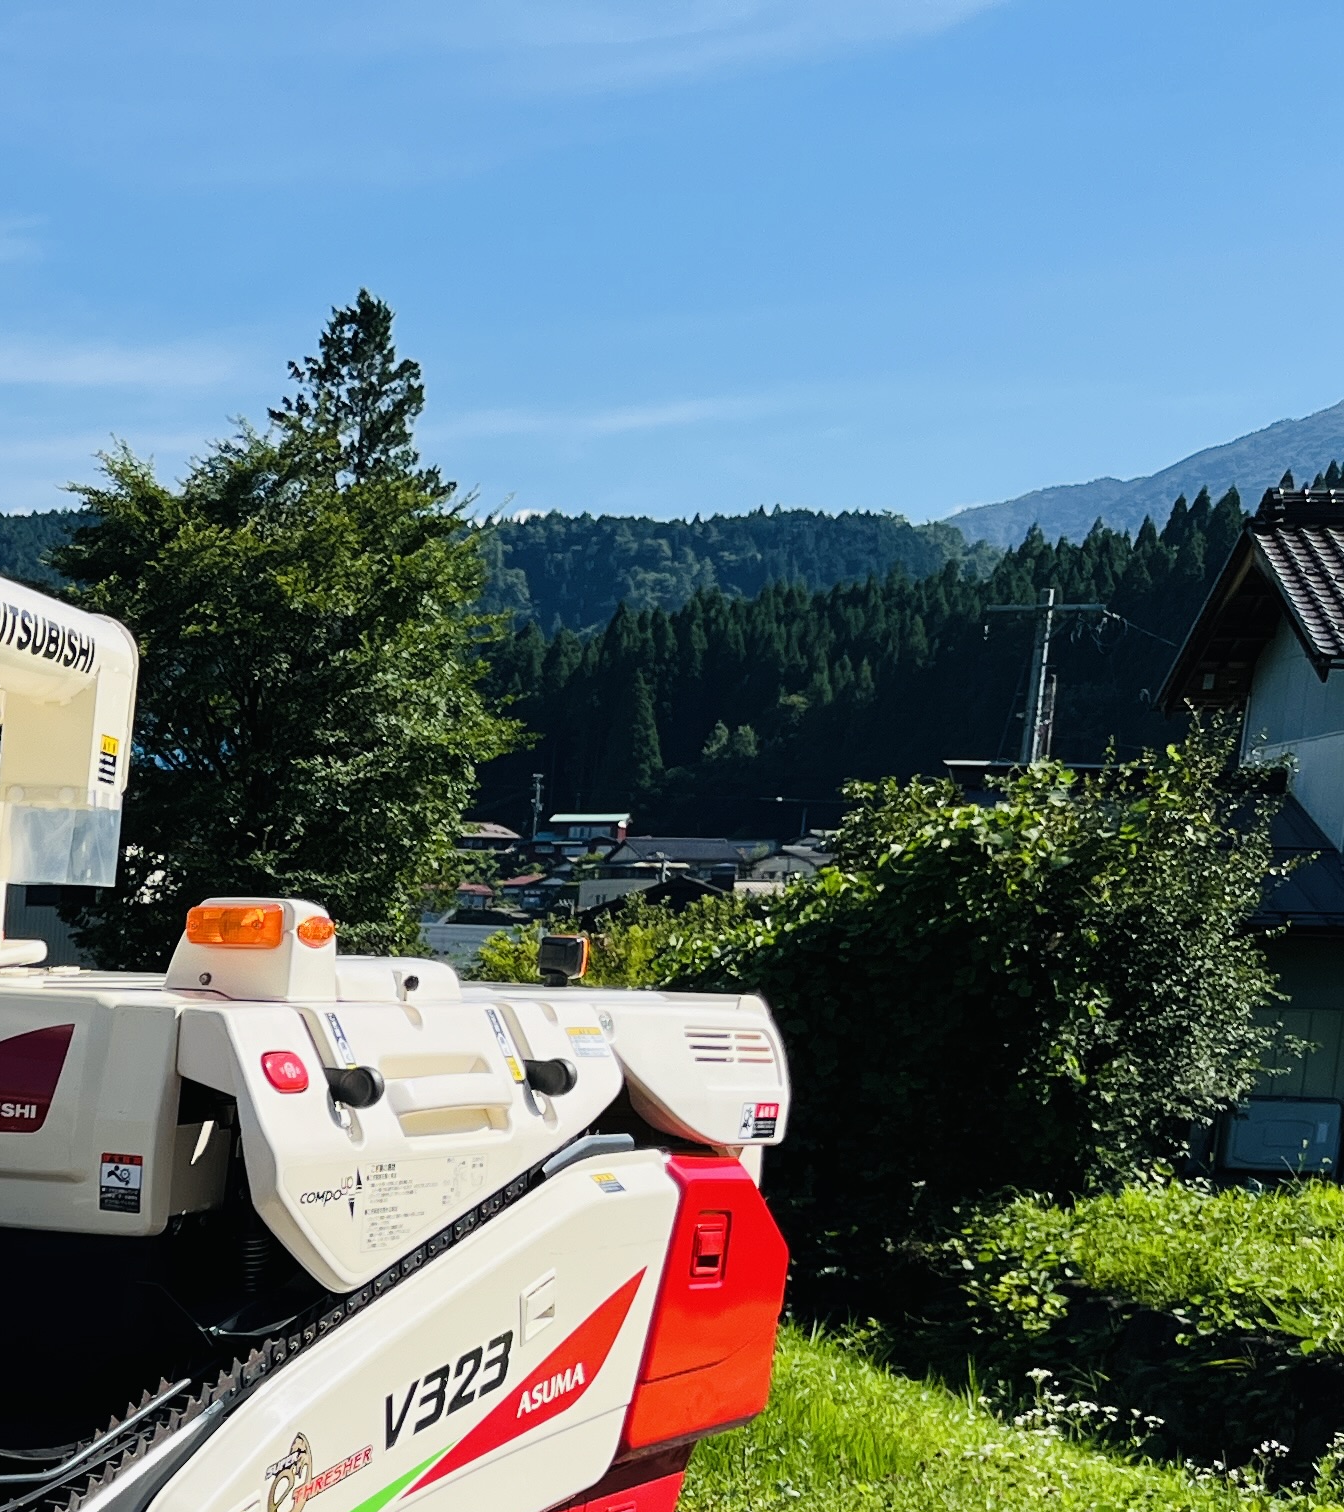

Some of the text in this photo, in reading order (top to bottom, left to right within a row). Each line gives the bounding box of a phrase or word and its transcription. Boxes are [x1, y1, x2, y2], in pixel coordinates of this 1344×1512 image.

[384, 1329, 514, 1452] V323
[515, 1361, 586, 1419] ASUMA
[265, 1450, 301, 1481] SUPER
[292, 1445, 373, 1504] THRESHER
